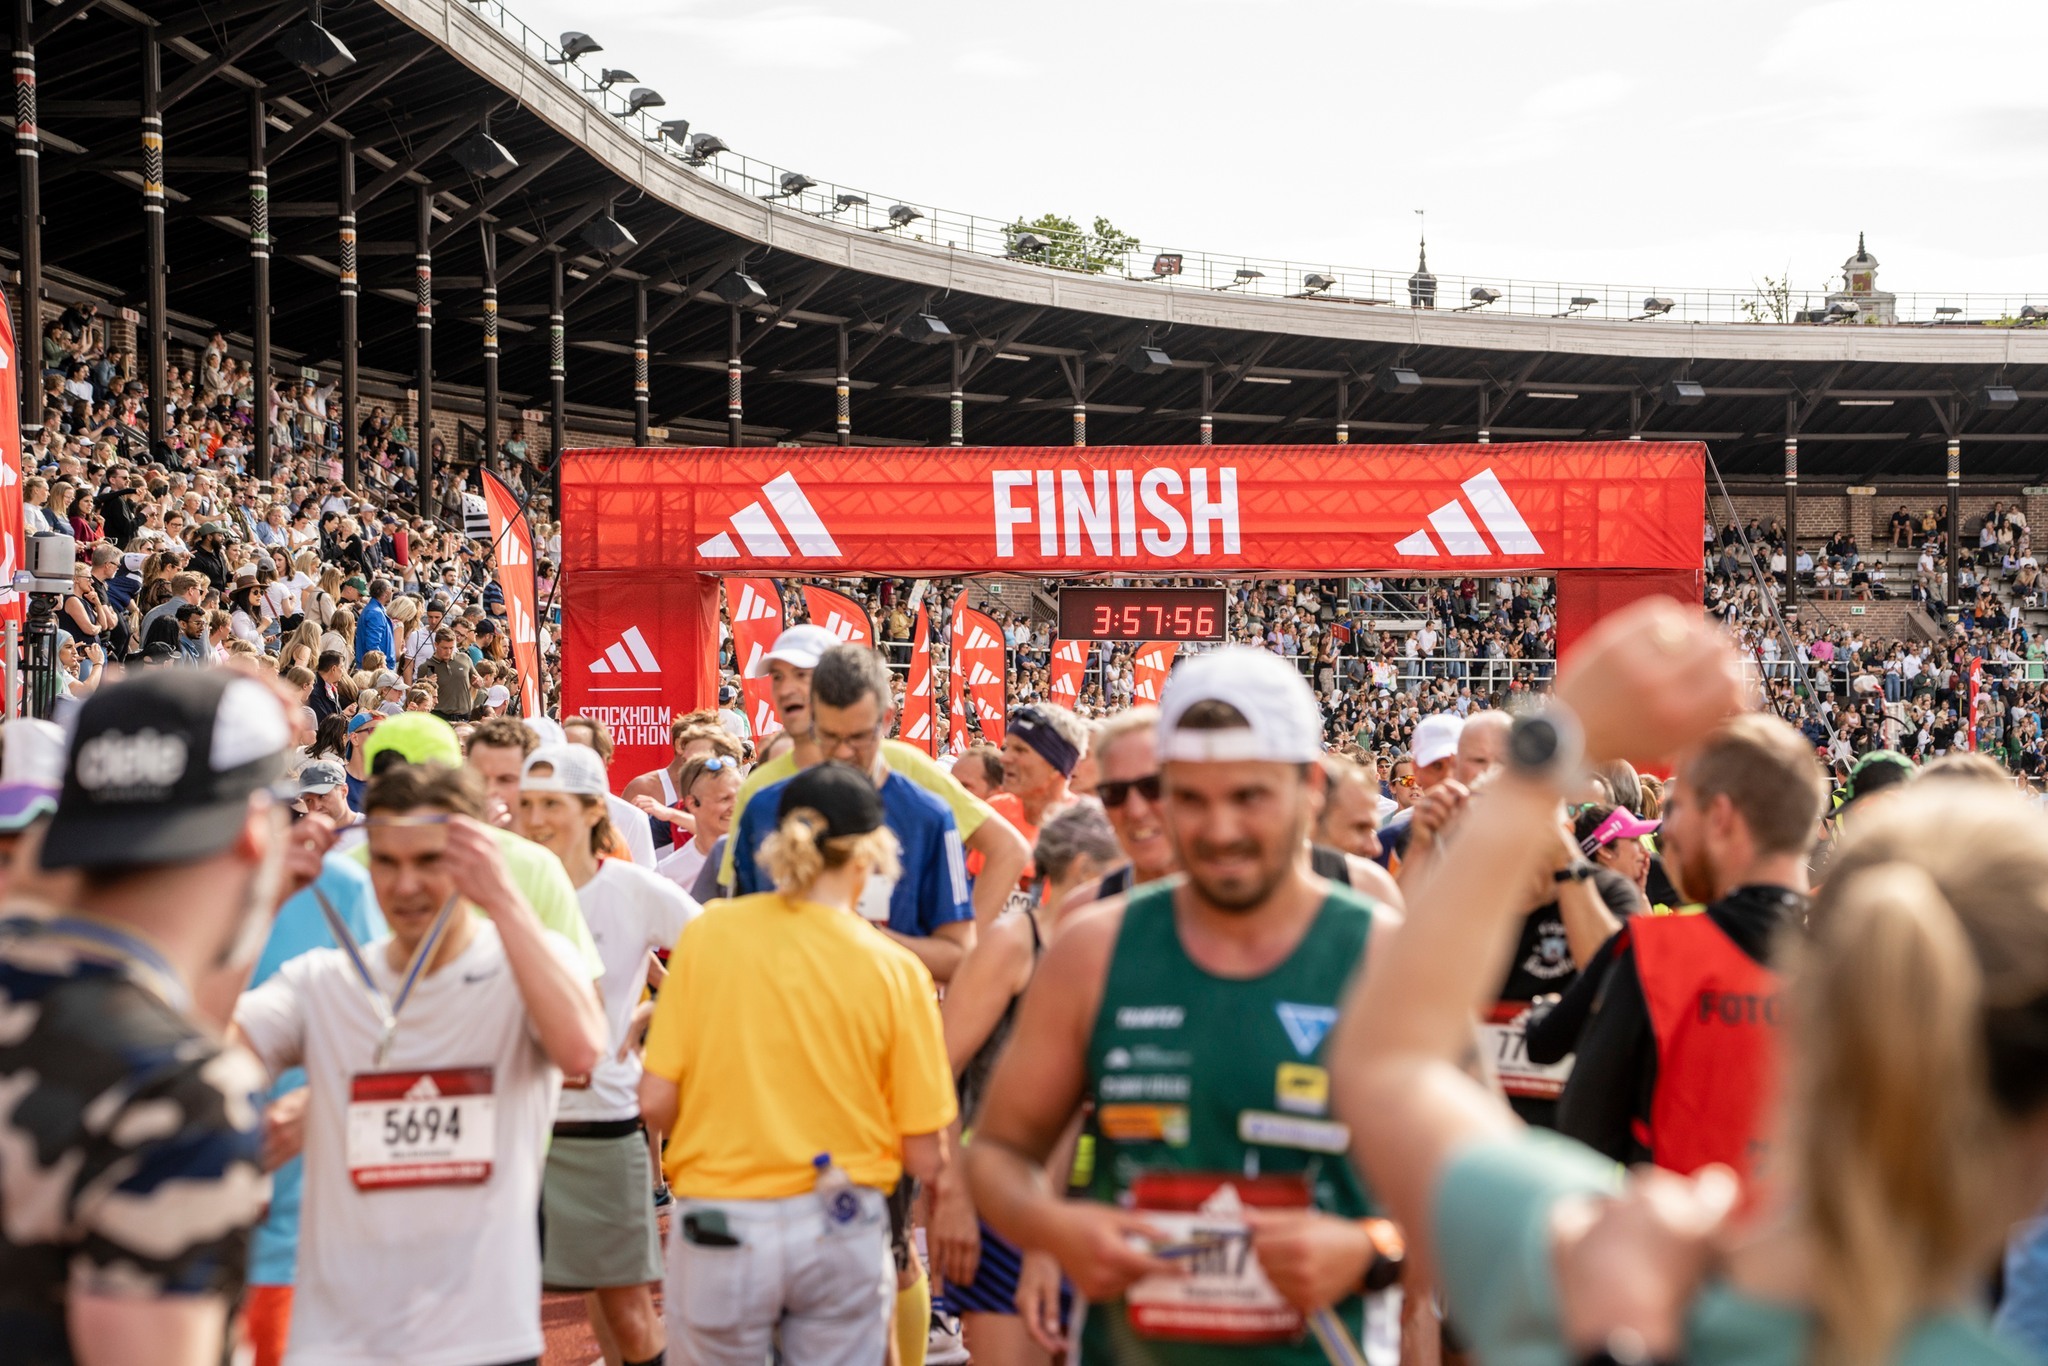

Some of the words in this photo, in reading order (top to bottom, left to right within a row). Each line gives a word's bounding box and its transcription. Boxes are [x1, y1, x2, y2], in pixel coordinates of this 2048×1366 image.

[992, 467, 1241, 557] FINISH
[1093, 606, 1215, 635] 3:57:56
[580, 706, 671, 726] STOCKHOLM
[384, 1106, 460, 1146] 5694
